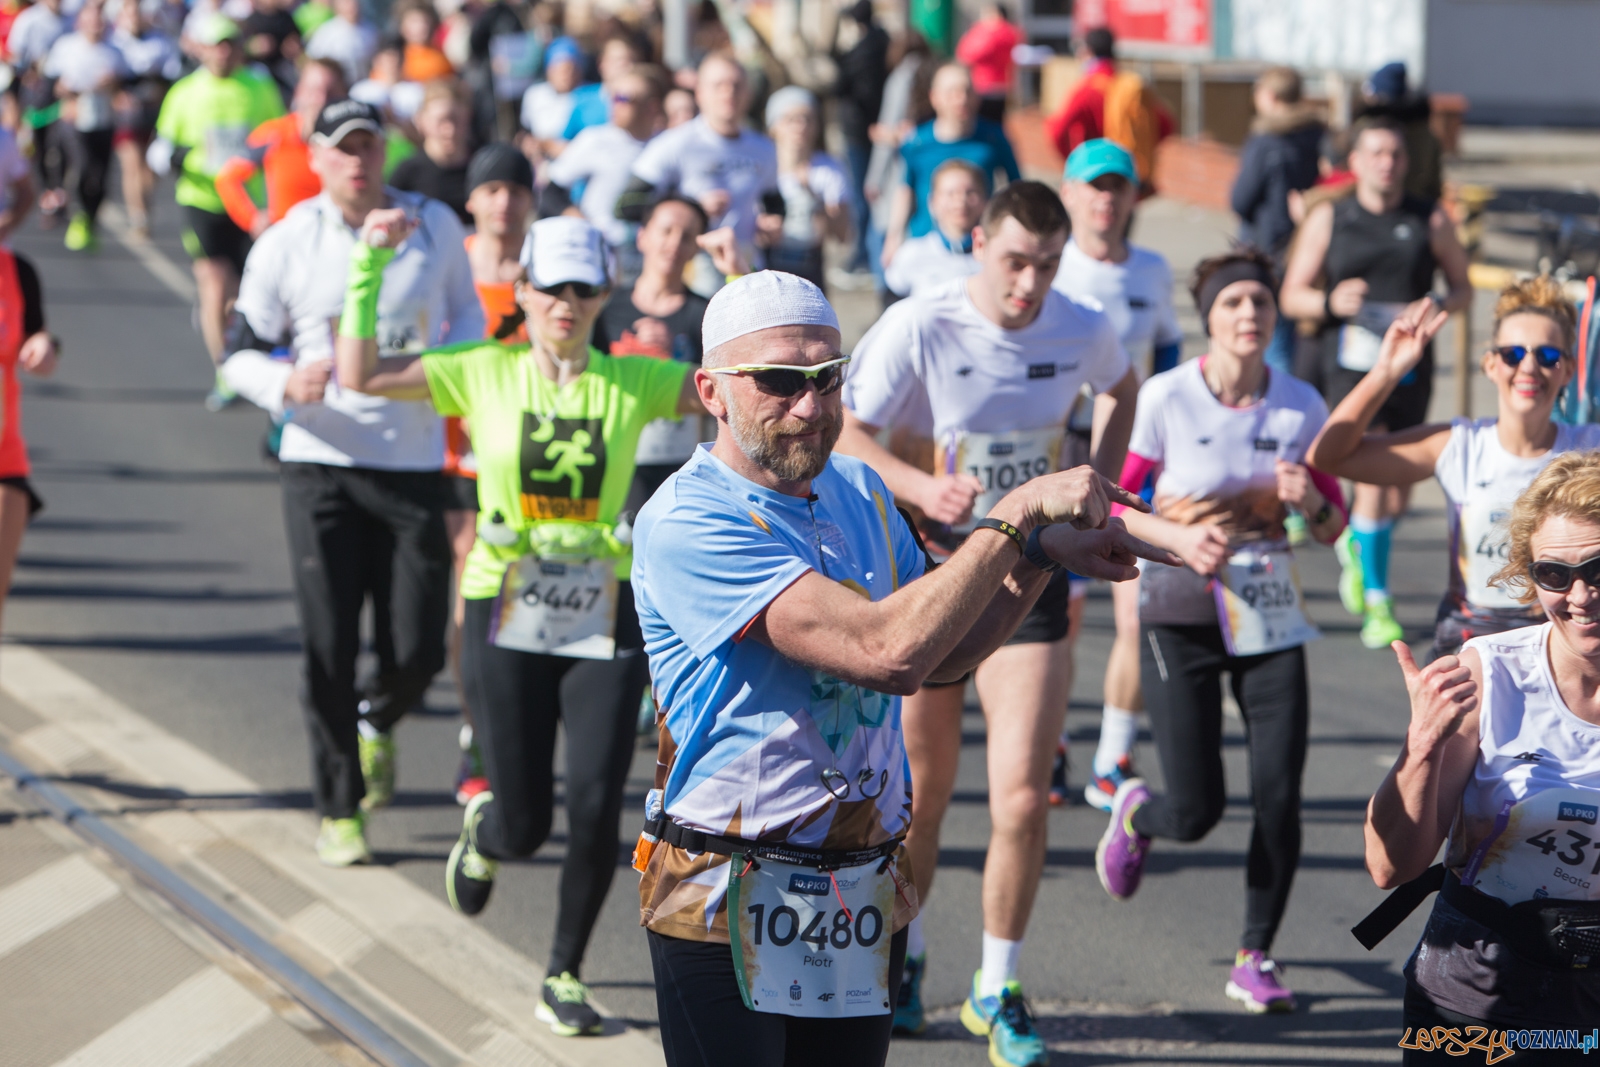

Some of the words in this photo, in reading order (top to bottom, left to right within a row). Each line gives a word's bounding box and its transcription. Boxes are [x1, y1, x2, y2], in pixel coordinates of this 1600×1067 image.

[523, 582, 603, 613] 6447
[759, 845, 823, 860] performance
[766, 852, 804, 864] recovery
[1553, 866, 1591, 890] Beata
[747, 903, 883, 950] 10480
[803, 955, 833, 968] Piotr
[817, 992, 836, 1002] 4F
